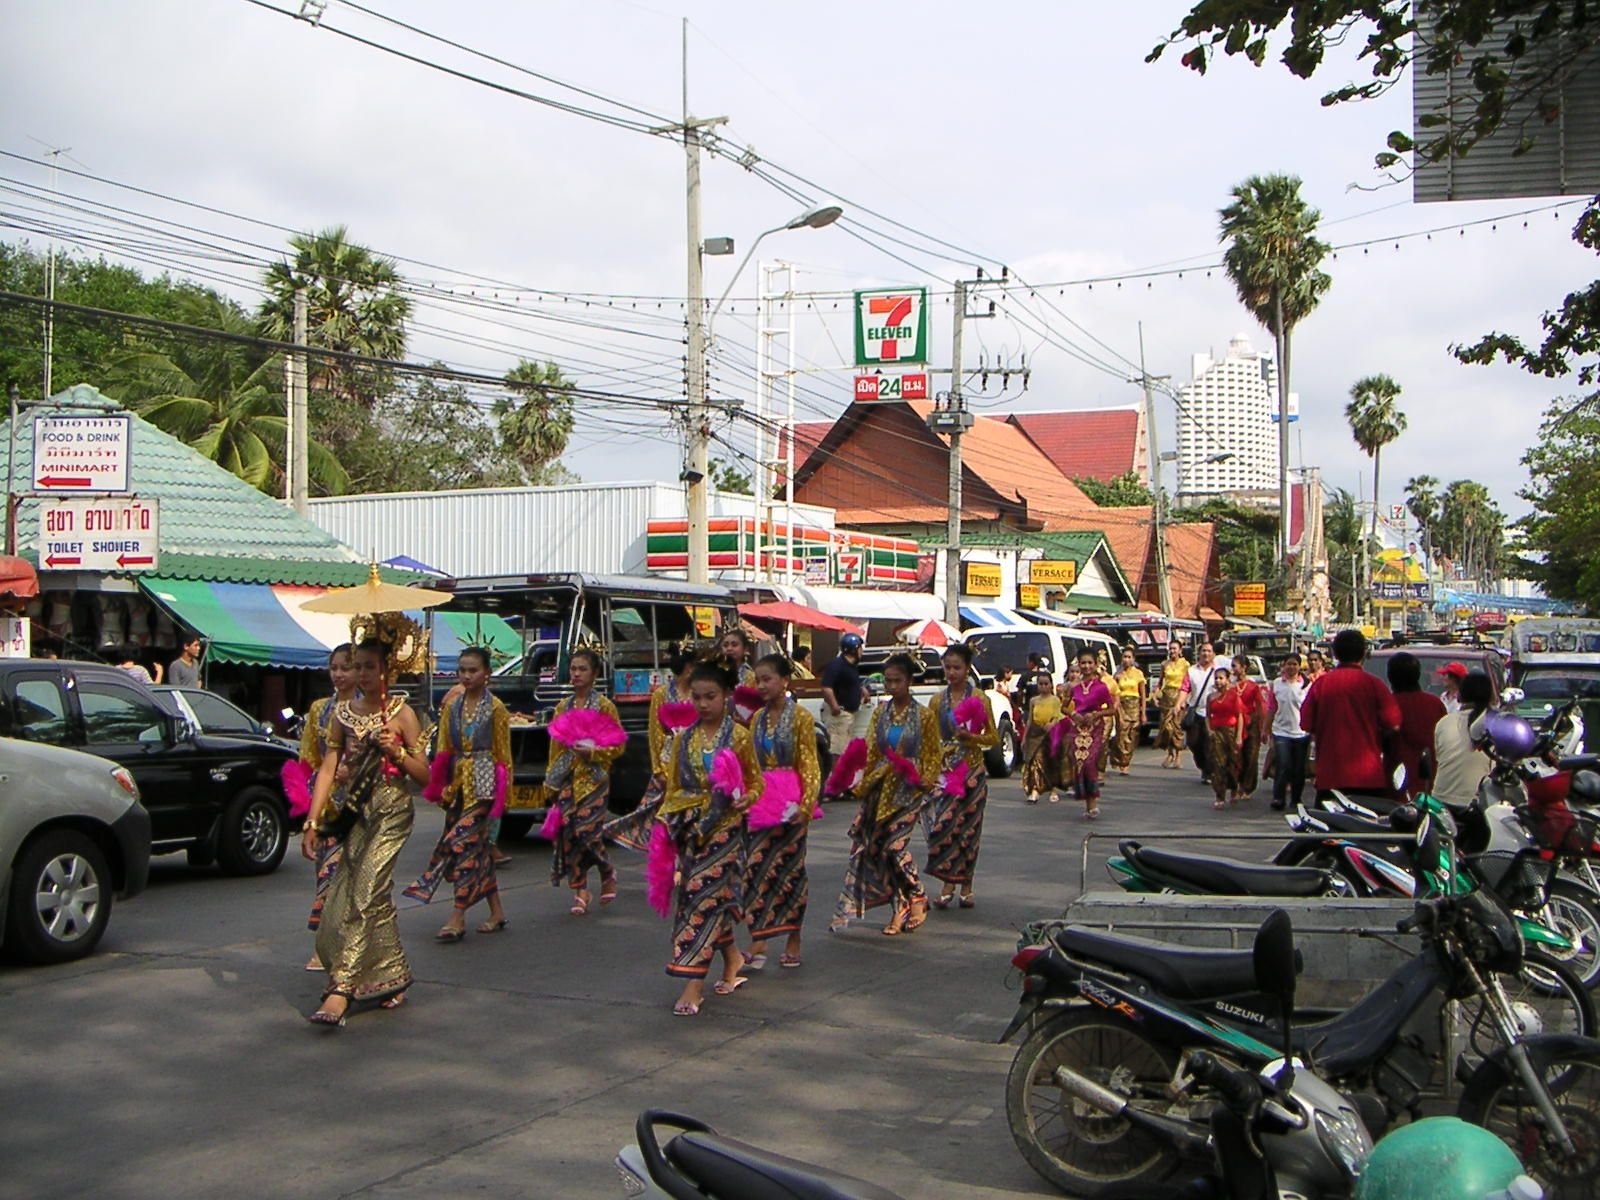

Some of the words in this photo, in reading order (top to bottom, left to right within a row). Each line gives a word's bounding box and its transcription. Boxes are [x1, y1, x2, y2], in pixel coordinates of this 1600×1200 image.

[869, 296, 912, 359] 7
[857, 379, 877, 393] เปิด
[879, 378, 901, 396] 24
[42, 433, 73, 442] FOOD
[76, 433, 84, 442] &
[87, 433, 120, 442] DRINK
[41, 464, 118, 472] MINIMART
[47, 509, 73, 536] สุขา
[47, 542, 84, 553] TOILET
[92, 541, 140, 552] SHOWER
[1032, 568, 1073, 578] VERSACE
[970, 574, 999, 587] VERSACE
[1215, 1001, 1265, 1024] SUZUKI
